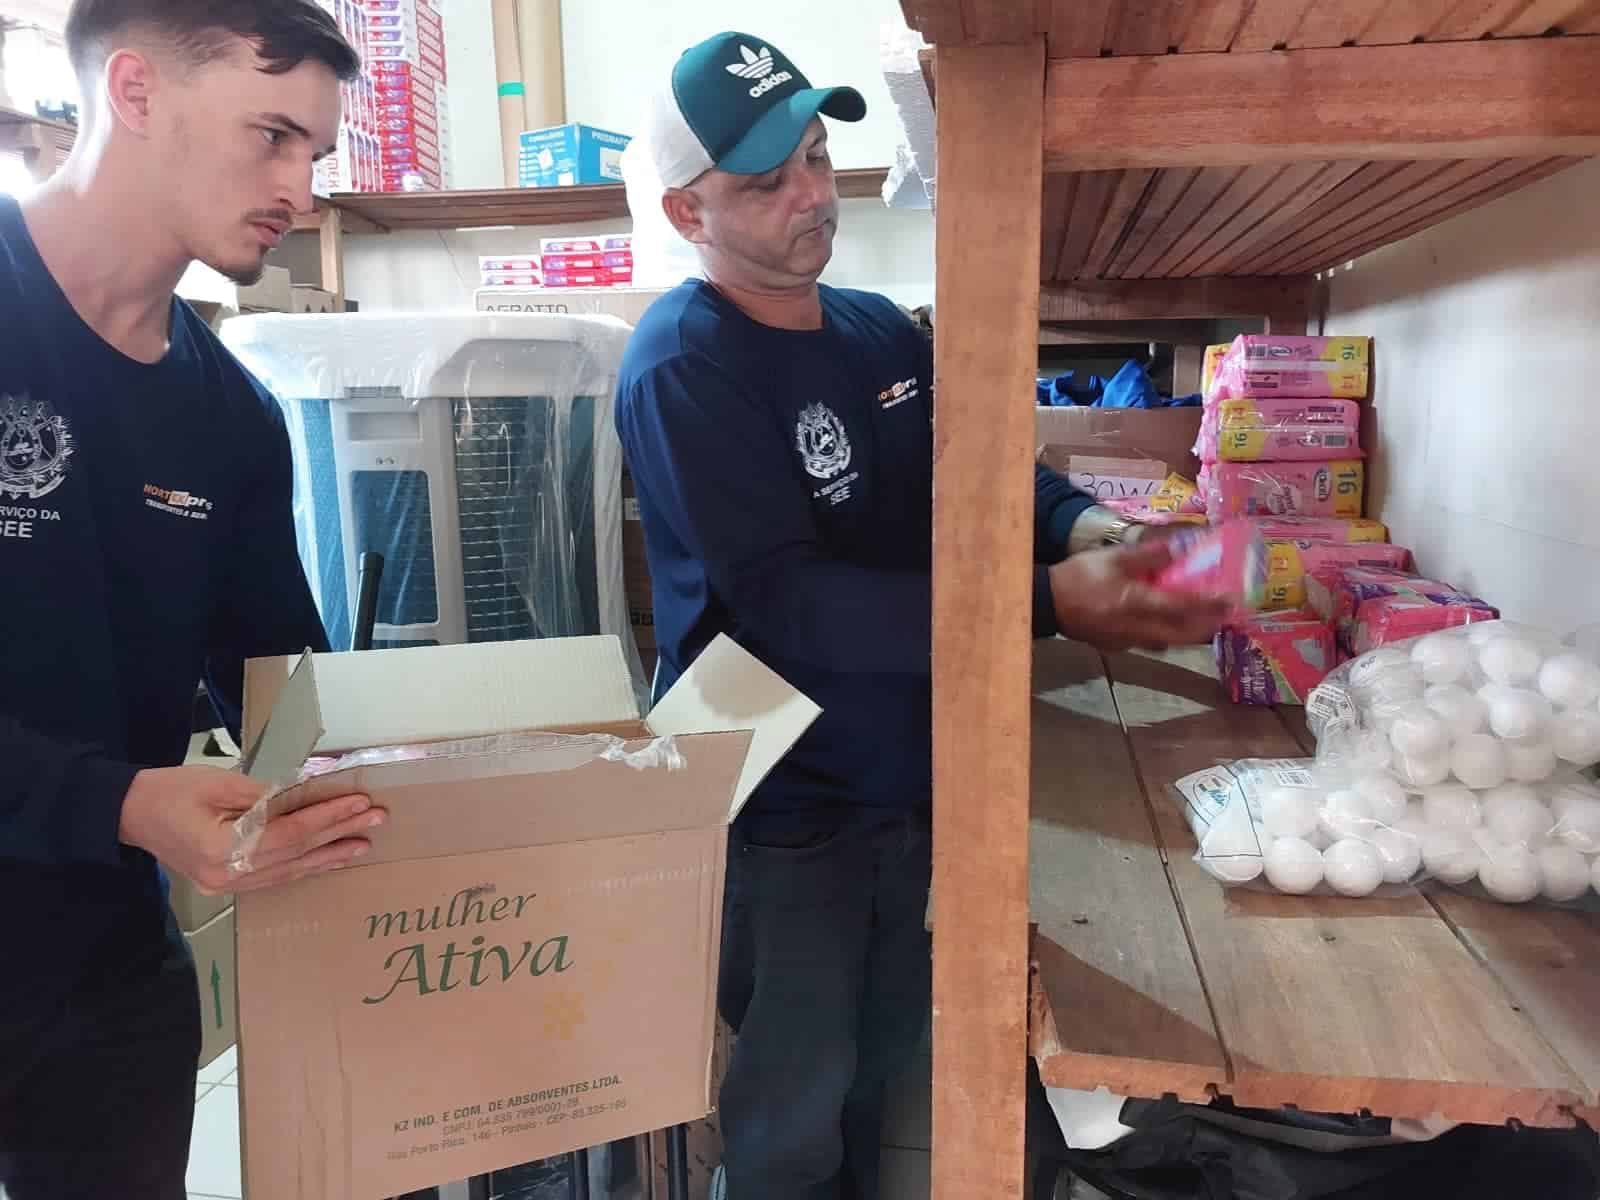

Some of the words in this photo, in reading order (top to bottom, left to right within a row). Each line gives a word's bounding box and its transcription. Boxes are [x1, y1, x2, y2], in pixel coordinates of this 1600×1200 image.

[749, 71, 793, 98] adidas
[1337, 471, 1359, 495] 16
[0, 520, 33, 538] EE
[40, 510, 61, 521] DA
[366, 888, 536, 939] mulher
[362, 935, 575, 1004] Ativa
[442, 1111, 450, 1122] E
[488, 1099, 503, 1112] DE
[507, 1081, 589, 1107] ABSORVENTES
